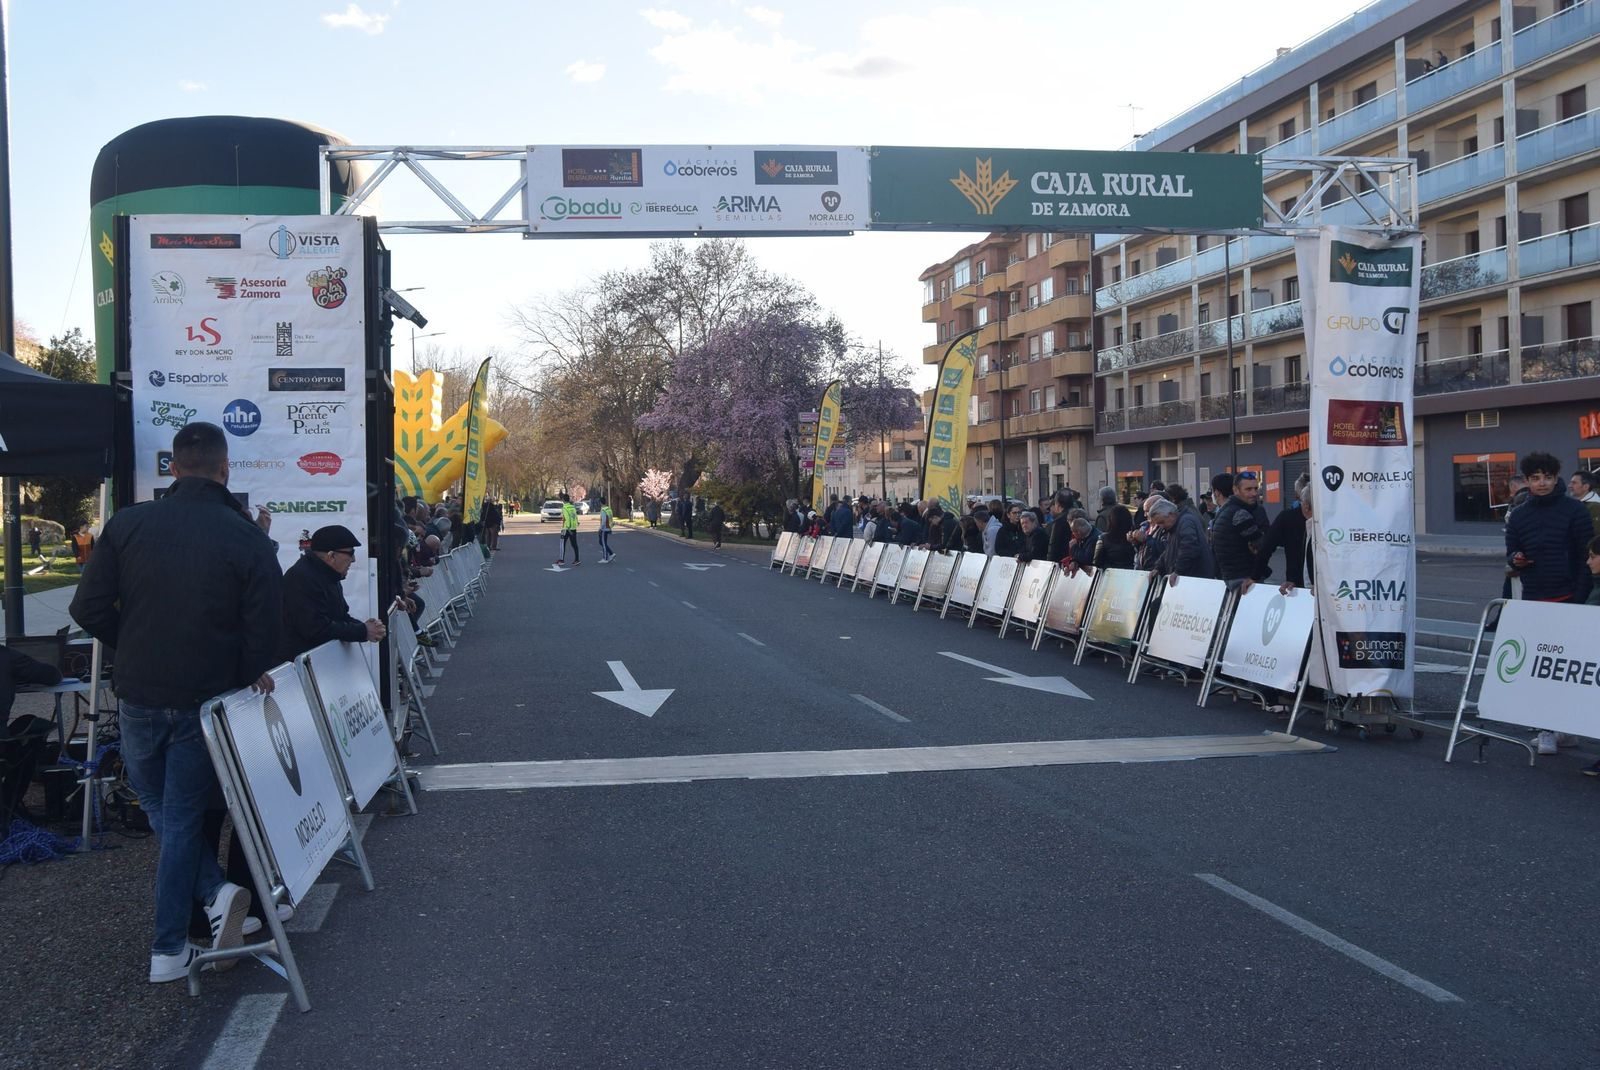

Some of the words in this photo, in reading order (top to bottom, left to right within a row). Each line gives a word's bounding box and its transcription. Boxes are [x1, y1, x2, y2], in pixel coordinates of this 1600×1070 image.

[677, 165, 738, 177] cobreros
[784, 164, 803, 172] CAJA
[805, 164, 833, 172] RURAL
[1030, 171, 1096, 196] CAJA
[1101, 173, 1193, 198] RURAL
[540, 196, 622, 221] Cobadu
[645, 203, 699, 213] IBEREÓLICA
[1031, 203, 1054, 217] DE
[1058, 203, 1131, 218] ZAMORA
[716, 214, 782, 222] SEMILLAS
[809, 213, 855, 222] MORALEJO
[298, 235, 340, 246] VISTA
[298, 246, 341, 255] ALEGRE
[1357, 262, 1376, 272] CAJA
[1378, 263, 1409, 272] RURAL
[239, 276, 287, 287] Asesoría
[239, 289, 281, 299] Zamora
[1327, 314, 1380, 332] GRUPO
[1347, 363, 1404, 379] cobreros
[168, 371, 229, 385] Espabrok
[278, 376, 311, 384] CENTRO
[311, 373, 343, 383] ÓPTICO
[287, 404, 328, 421] Puente
[293, 419, 331, 435] Piedra
[1332, 422, 1355, 431] HOTEL
[1332, 430, 1379, 439] RESTAURANTE
[1349, 530, 1411, 544] IBEREÓLICA
[1536, 643, 1564, 654] GRUPO
[1243, 652, 1278, 671] MORALEJO
[295, 801, 326, 849] MORALEJO
